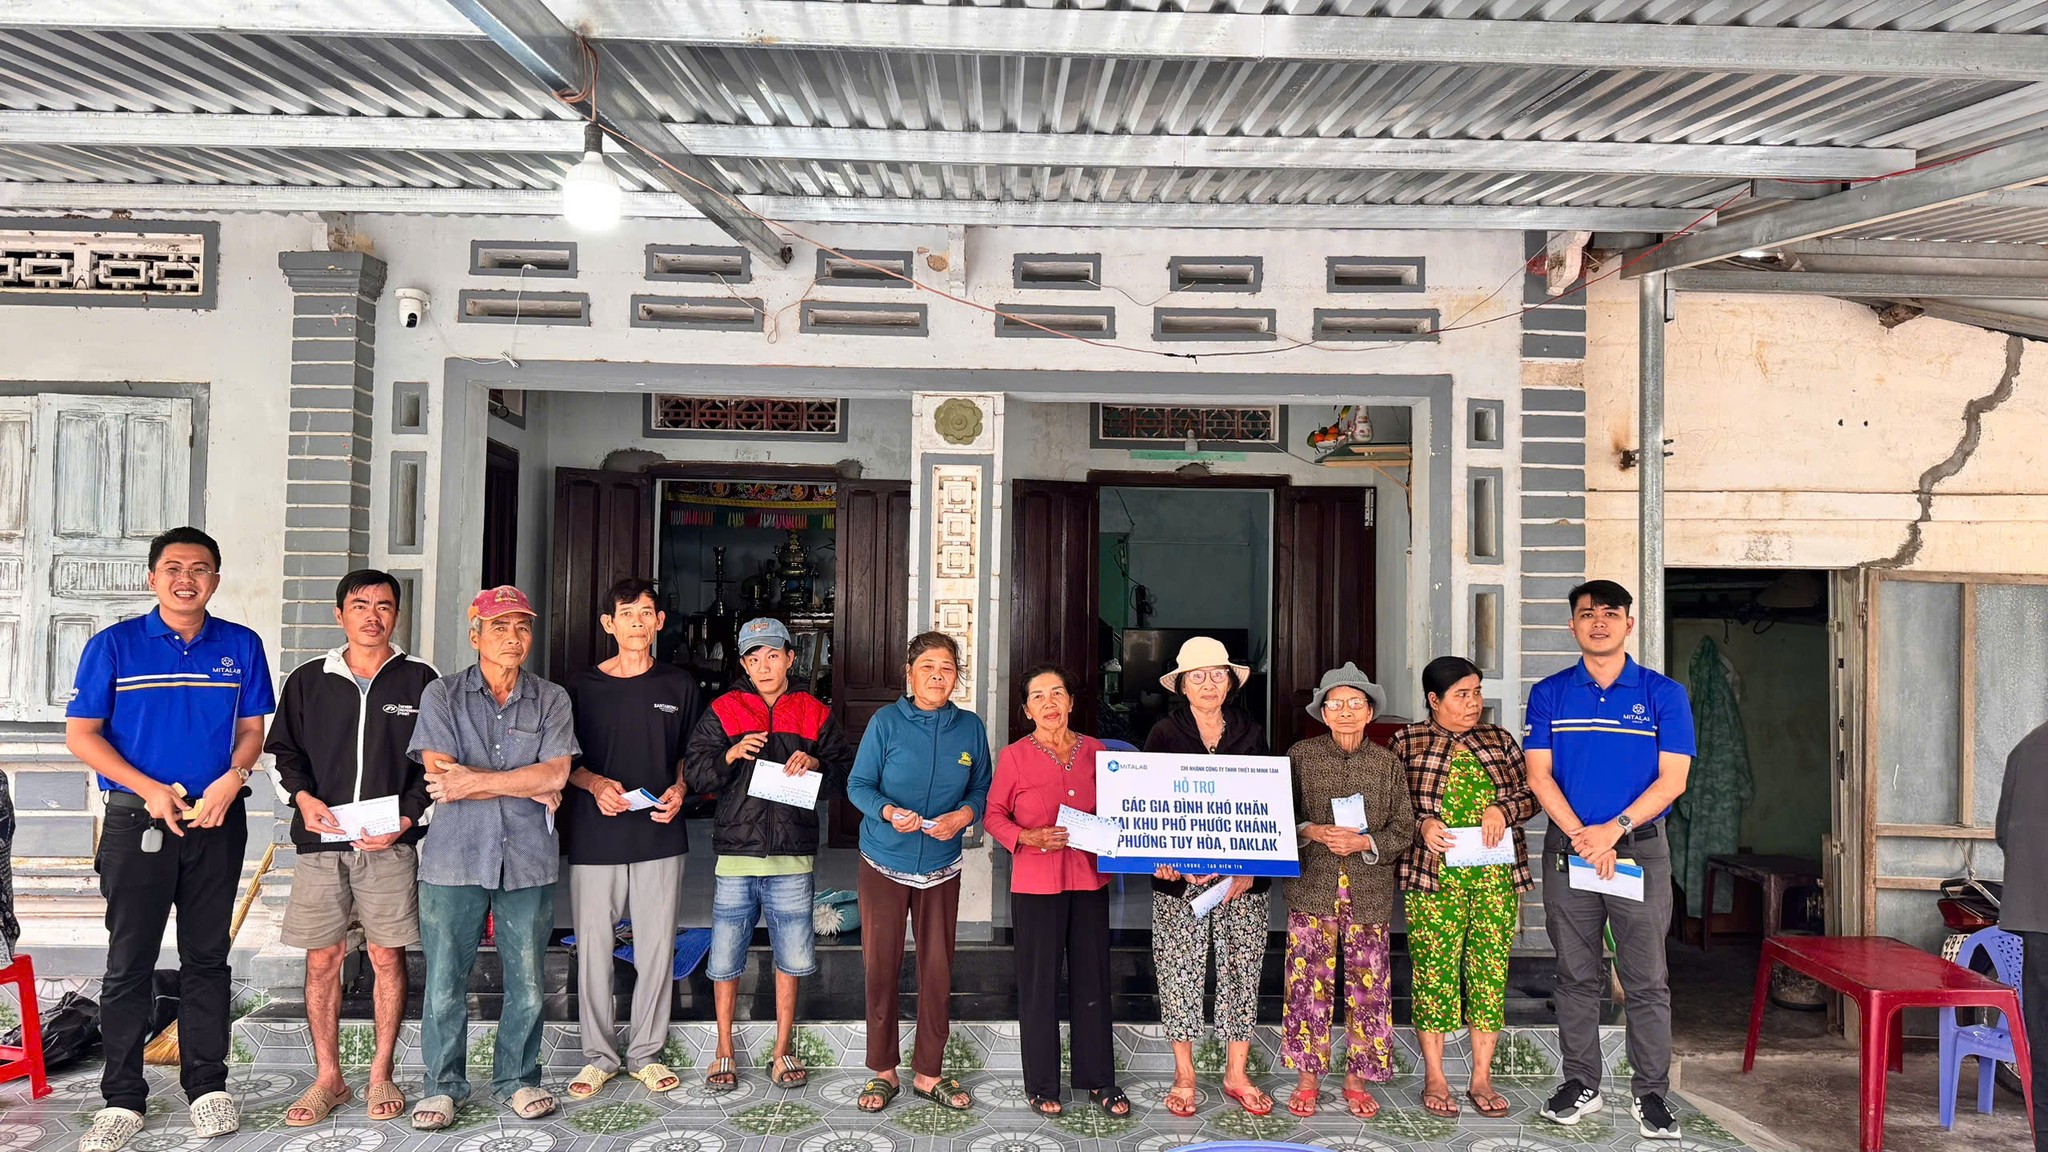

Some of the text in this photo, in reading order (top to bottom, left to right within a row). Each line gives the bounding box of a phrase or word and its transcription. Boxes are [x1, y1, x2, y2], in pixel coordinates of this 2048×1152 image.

[1193, 780, 1216, 796] TRỢ
[1122, 796, 1269, 816] CÁC GIA ĐÌNH KHÓ KHĂN
[1133, 817, 1158, 831] KHU
[1162, 815, 1186, 831] PHỐ
[1190, 816, 1232, 832] PHƯỚC
[1235, 817, 1281, 837] KHÁNH,
[1117, 832, 1278, 853] PHƯỜNG TUY HÒA, DAKLAK
